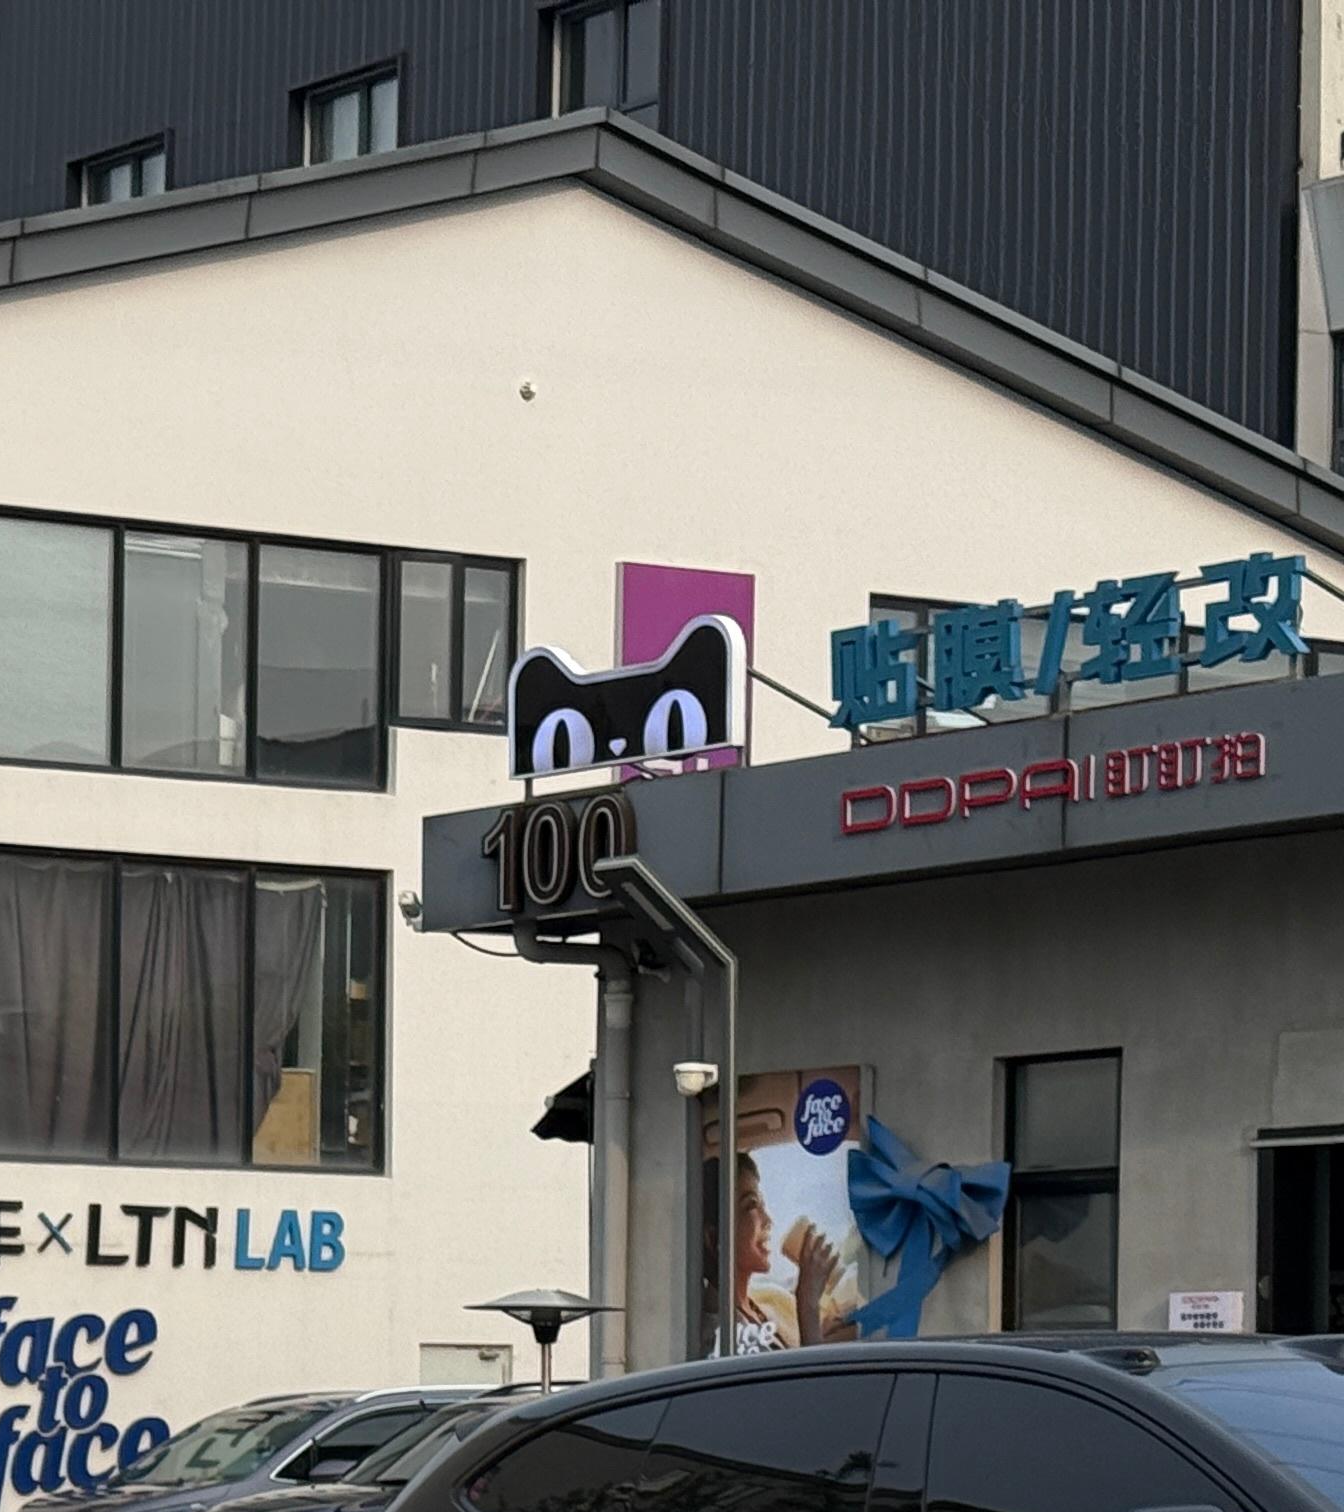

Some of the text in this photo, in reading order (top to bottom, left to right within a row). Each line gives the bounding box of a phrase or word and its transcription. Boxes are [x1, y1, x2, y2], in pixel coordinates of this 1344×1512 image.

[830, 552, 1310, 728] 贴膜/轻改
[483, 794, 634, 912] 100
[800, 1094, 843, 1122] face
[803, 1117, 845, 1145] face
[85, 1203, 219, 1269] LTN
[234, 1208, 346, 1272] LAB
[37, 1366, 109, 1435] to
